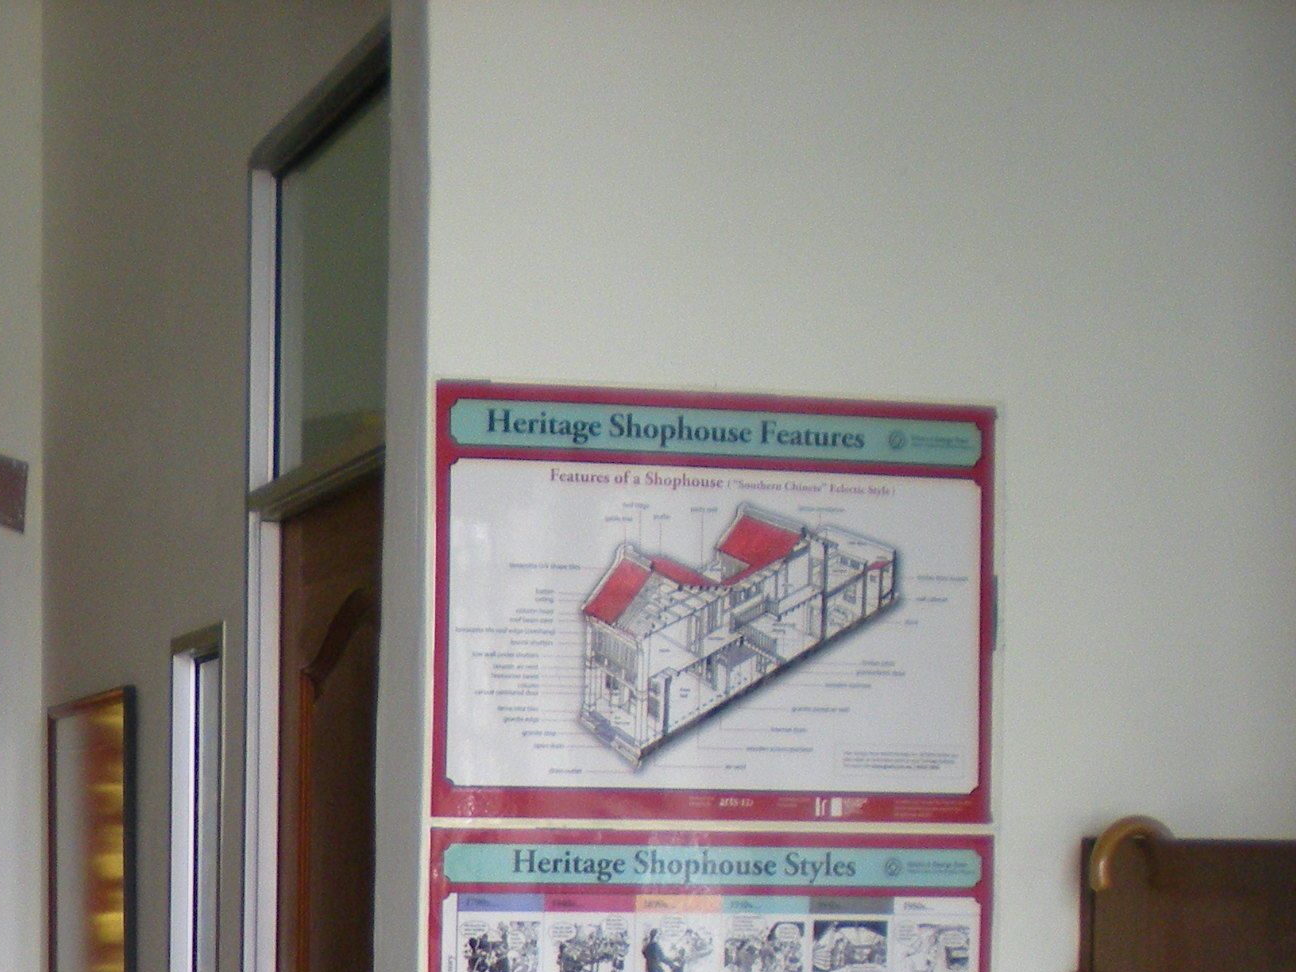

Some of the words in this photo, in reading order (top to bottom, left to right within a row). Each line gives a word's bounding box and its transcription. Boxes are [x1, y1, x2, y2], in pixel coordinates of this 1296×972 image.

[486, 409, 601, 445] Heritage
[608, 413, 752, 449] Shophouse
[759, 419, 866, 450] Features
[550, 467, 610, 485] Features
[614, 469, 632, 485] of
[632, 475, 641, 486] a
[645, 472, 724, 491] Shophouse
[512, 849, 626, 882] Heritage
[633, 850, 776, 884] Shophouse
[784, 852, 857, 883] Styles
